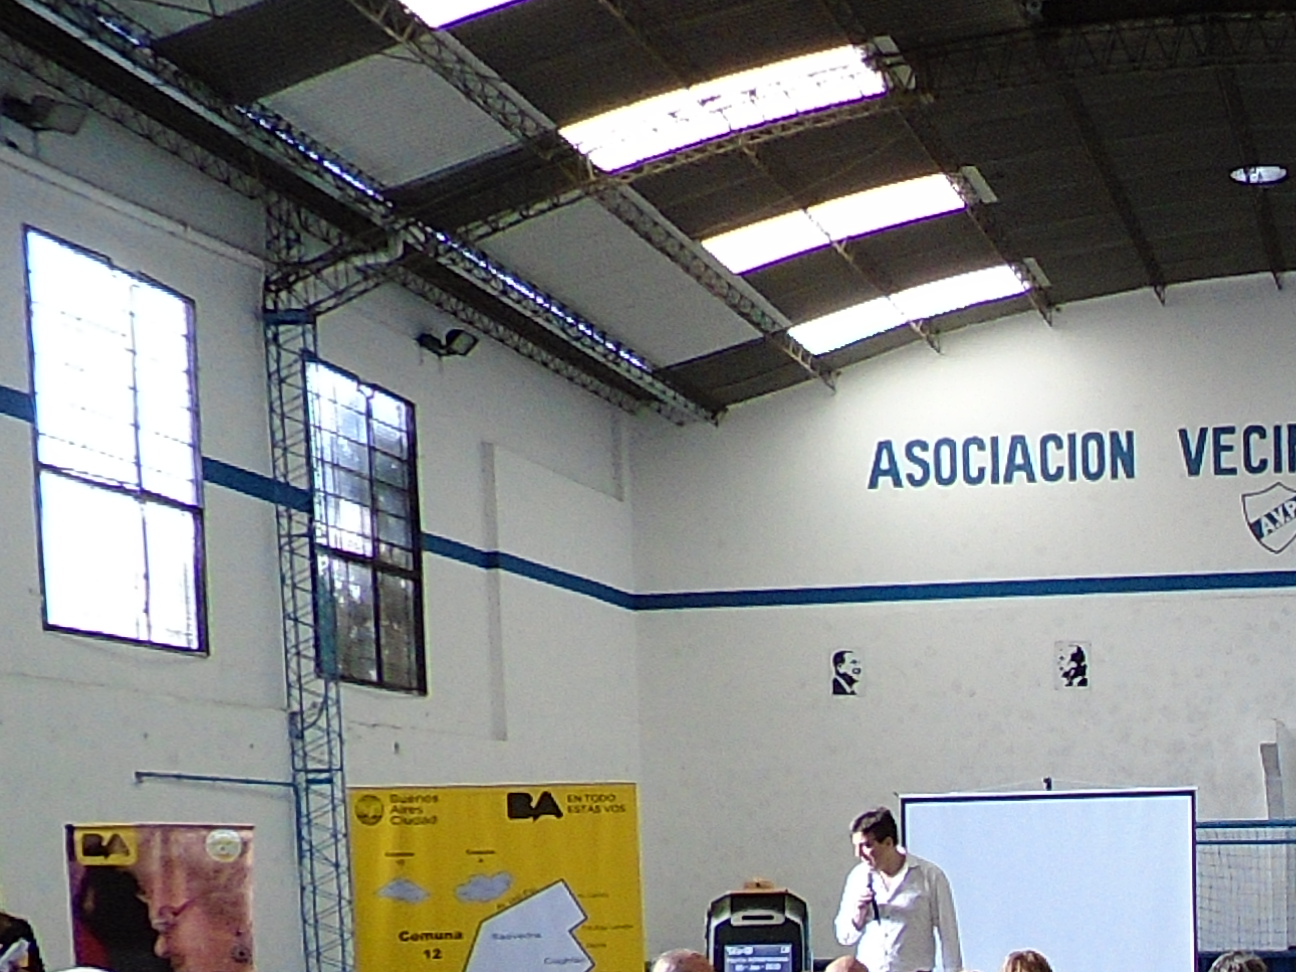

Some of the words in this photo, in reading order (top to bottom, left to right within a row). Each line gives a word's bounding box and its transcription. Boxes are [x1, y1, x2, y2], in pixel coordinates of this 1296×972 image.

[867, 430, 1135, 489] ASOCIACION
[507, 791, 564, 822] BA
[82, 834, 130, 858] BA
[398, 931, 463, 942] Comuna
[423, 948, 442, 959] 12
